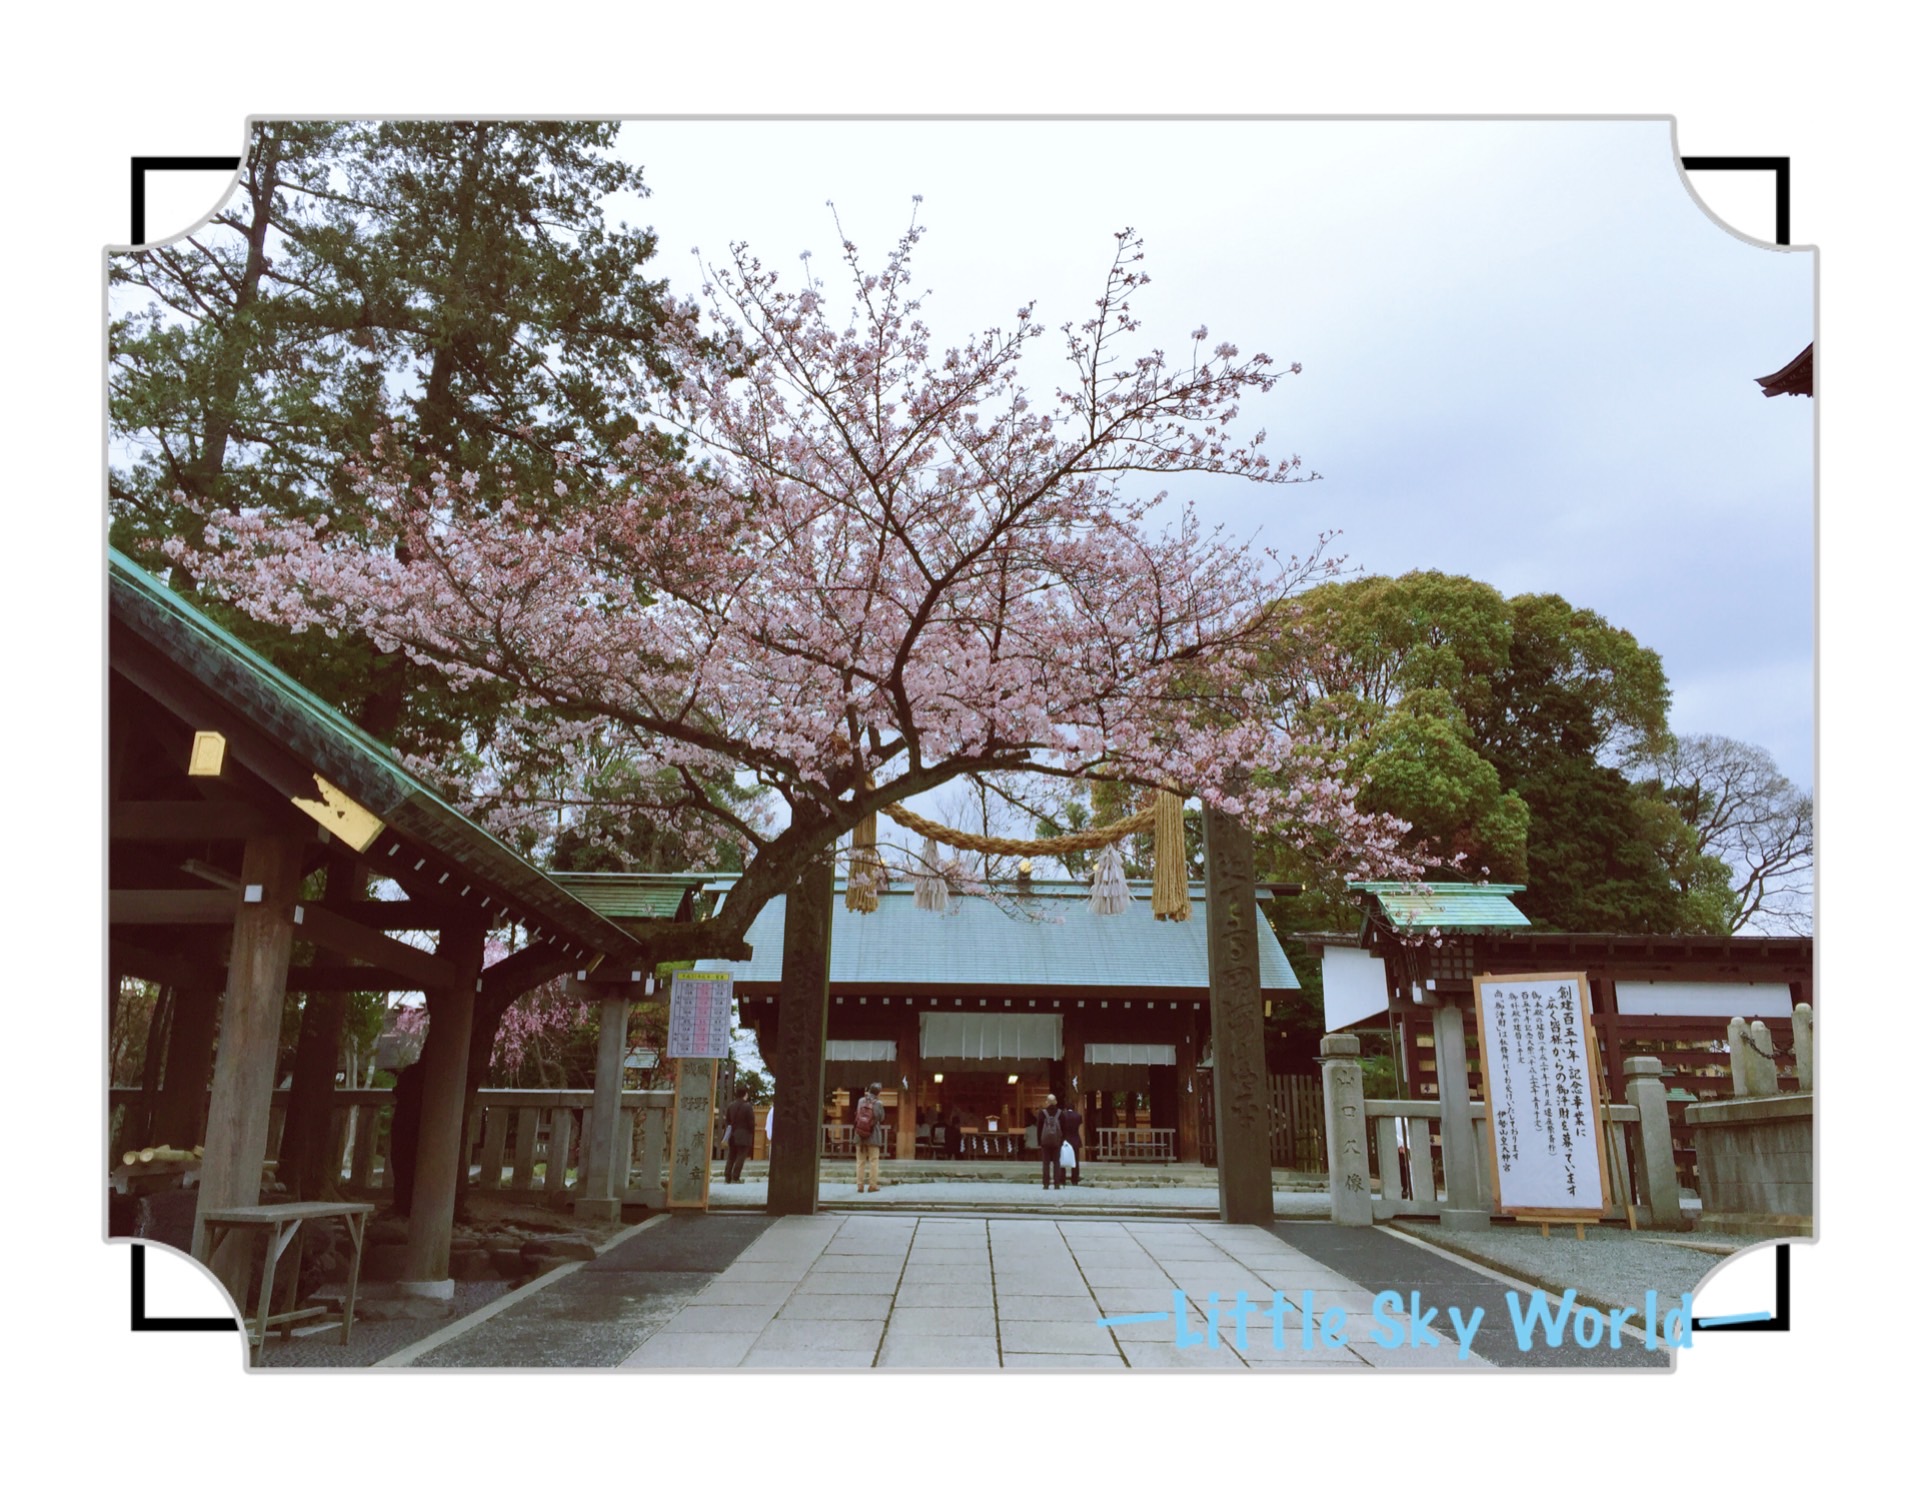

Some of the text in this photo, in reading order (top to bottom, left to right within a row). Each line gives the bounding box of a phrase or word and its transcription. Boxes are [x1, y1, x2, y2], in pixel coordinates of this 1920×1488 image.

[1497, 1110, 1511, 1172] 伊勢山皇大神宮
